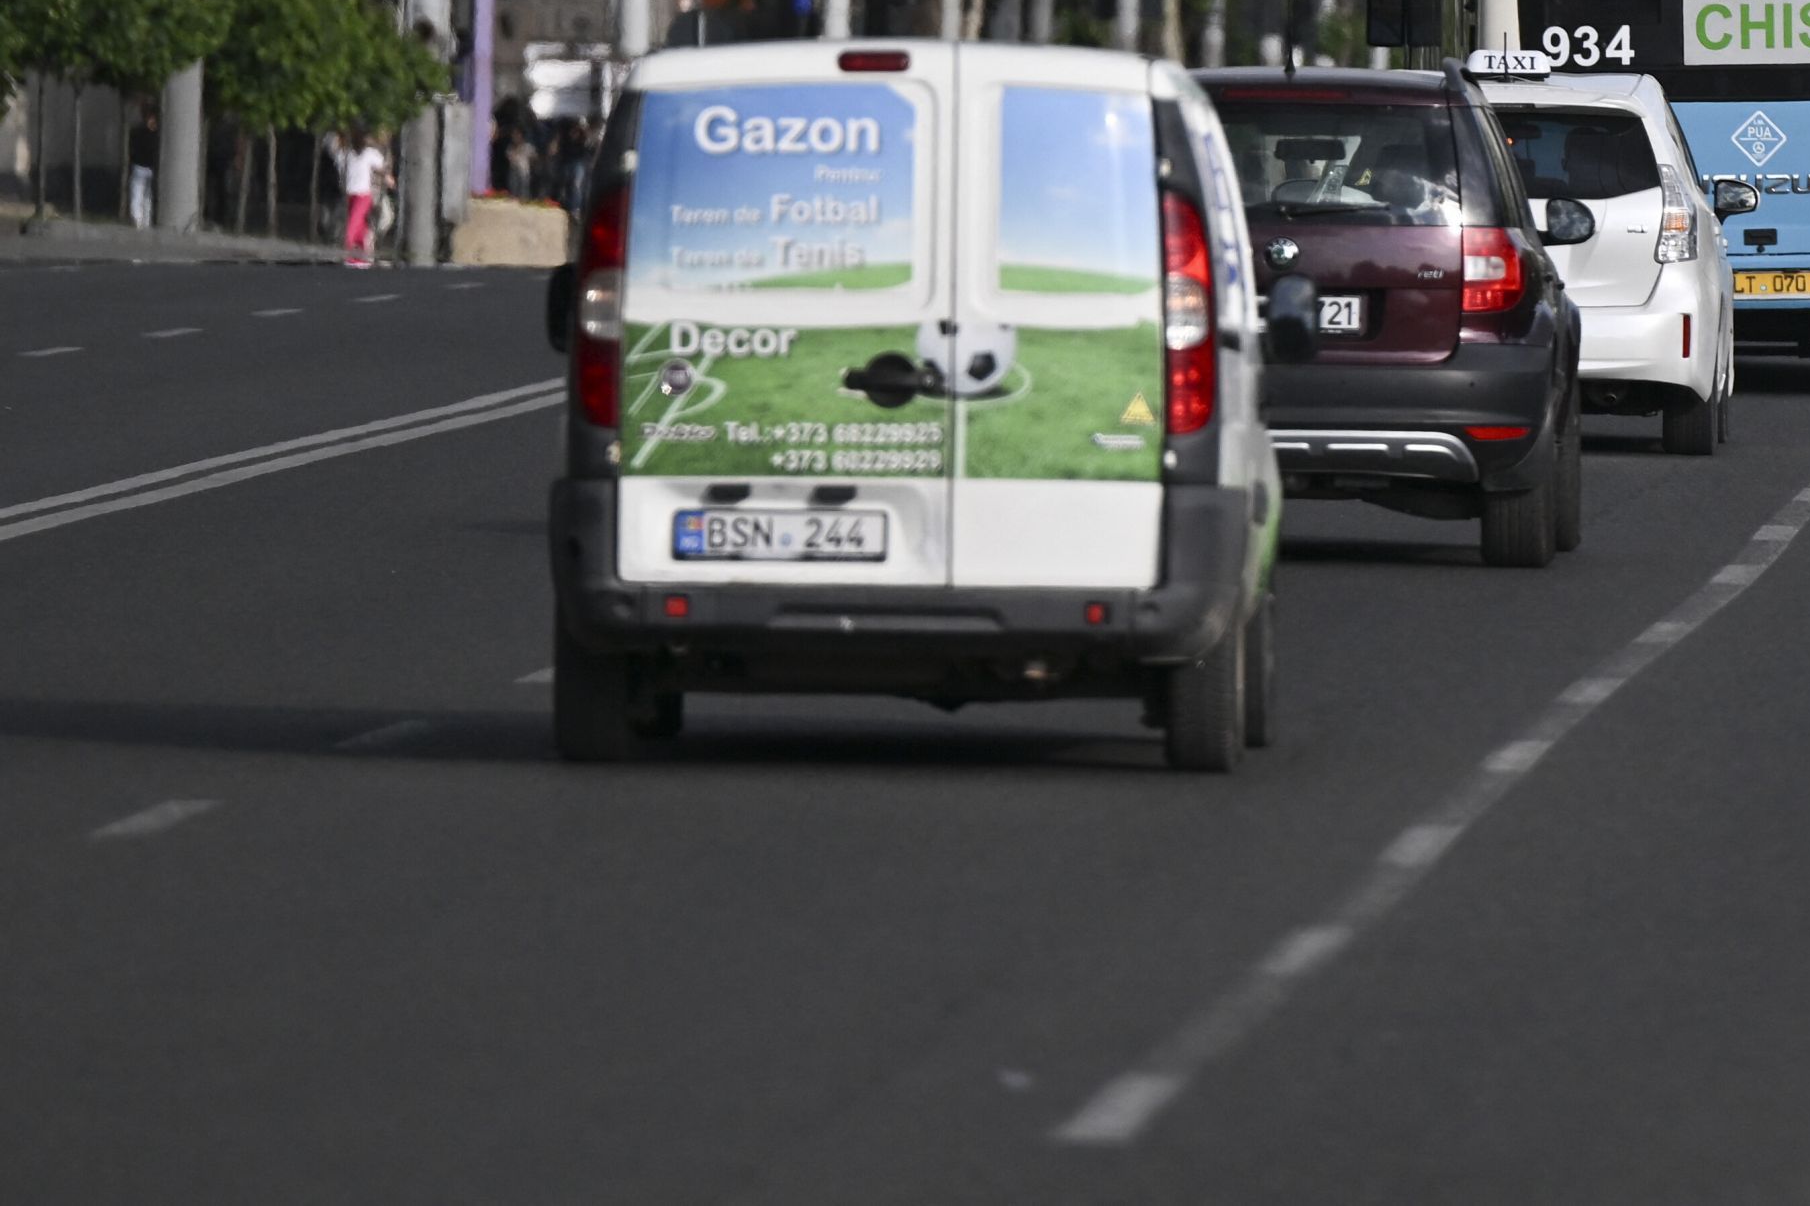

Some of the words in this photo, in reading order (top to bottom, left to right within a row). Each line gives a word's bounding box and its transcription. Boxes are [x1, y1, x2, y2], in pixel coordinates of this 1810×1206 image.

[1542, 24, 1635, 67] 934
[1483, 55, 1537, 71] TAXI
[694, 105, 881, 154] Gazon
[1747, 126, 1773, 139] PUA
[770, 194, 880, 225] Fotbal
[769, 235, 867, 269] Tenis
[1773, 274, 1806, 292] 070
[670, 320, 798, 358] Decor
[708, 516, 774, 548] BSN
[804, 517, 865, 548] 244
